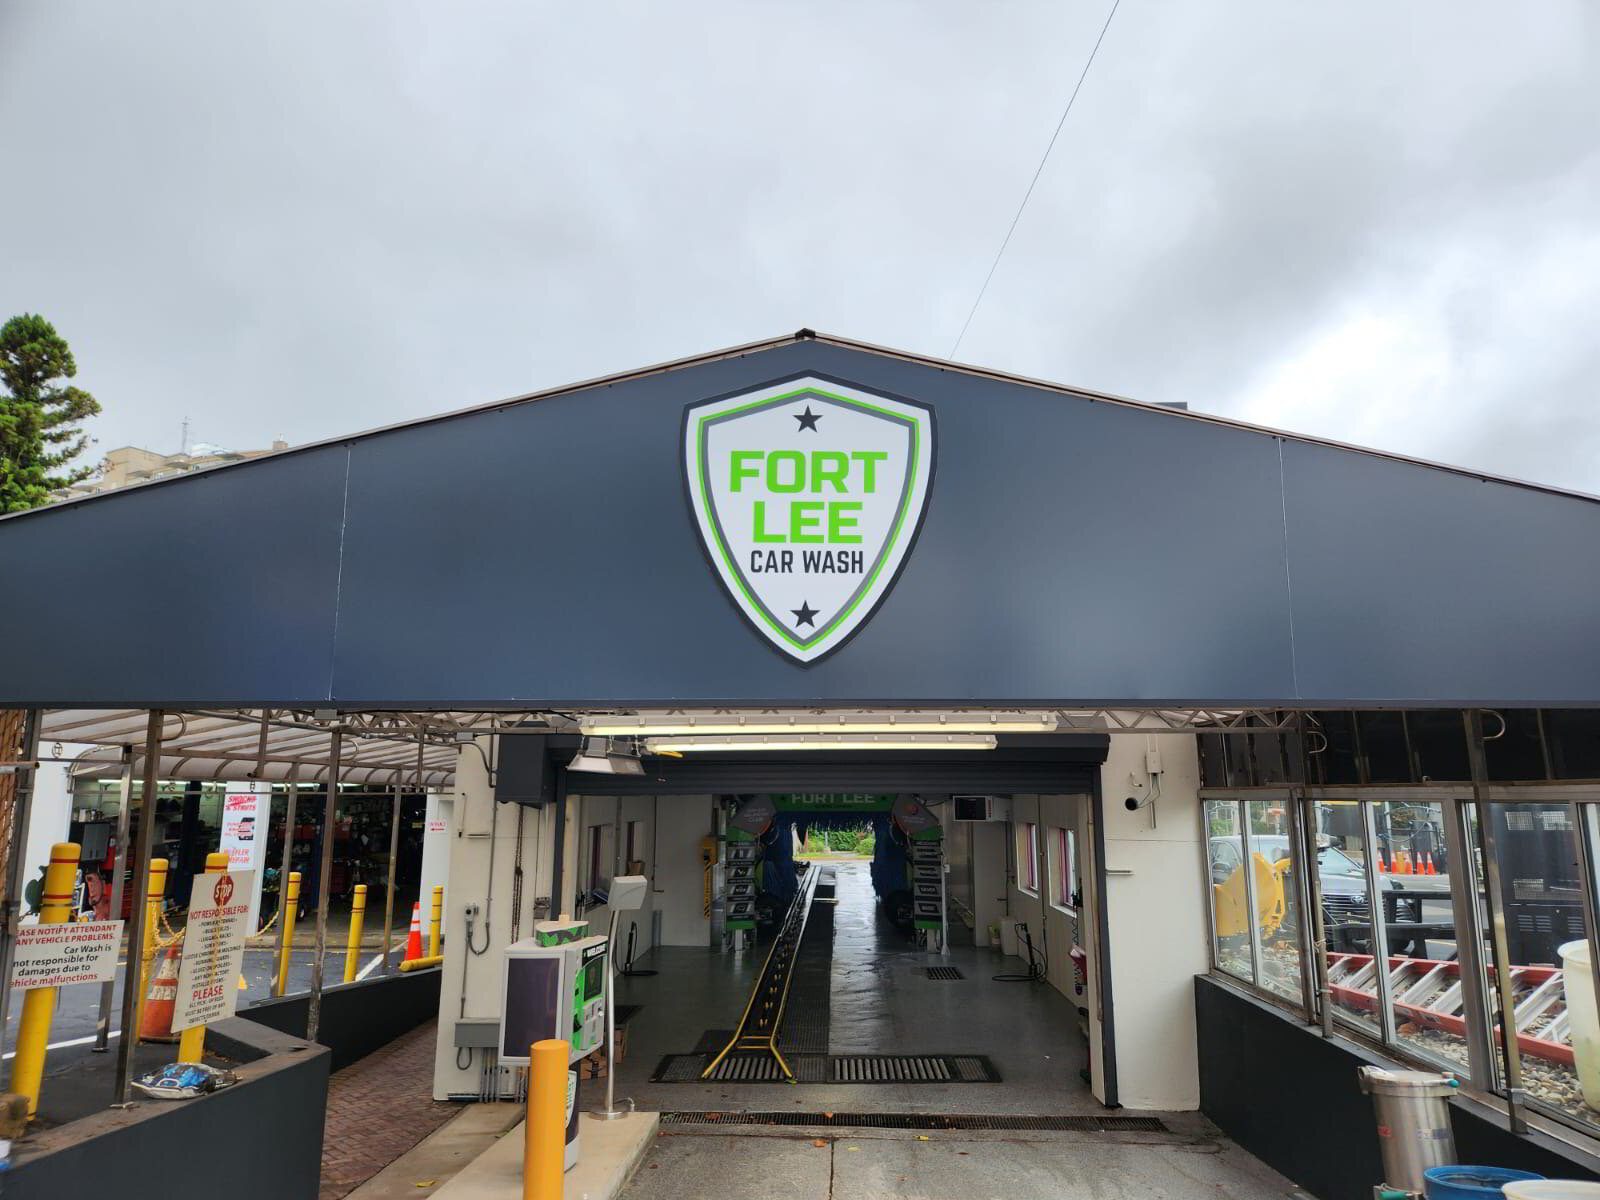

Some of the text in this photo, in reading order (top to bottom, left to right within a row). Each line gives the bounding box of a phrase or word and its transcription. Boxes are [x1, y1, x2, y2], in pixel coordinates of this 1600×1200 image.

[730, 450, 888, 494] FORT
[753, 501, 863, 544] LEE
[750, 550, 864, 574] CAR WASH
[202, 907, 237, 918] RESPOSIBLE
[37, 926, 68, 935] NOTIFY
[70, 924, 117, 933] ATTENDANT
[36, 936, 70, 945] VEHICLE
[71, 933, 115, 942] PROBLEMS.
[64, 946, 79, 954] Car
[80, 943, 103, 953] Wash
[31, 954, 84, 967] responsible
[86, 954, 99, 962] for
[18, 966, 60, 976] damages
[62, 964, 80, 973] due
[39, 973, 98, 986] malfunctions
[192, 985, 224, 1001] PLEASE
